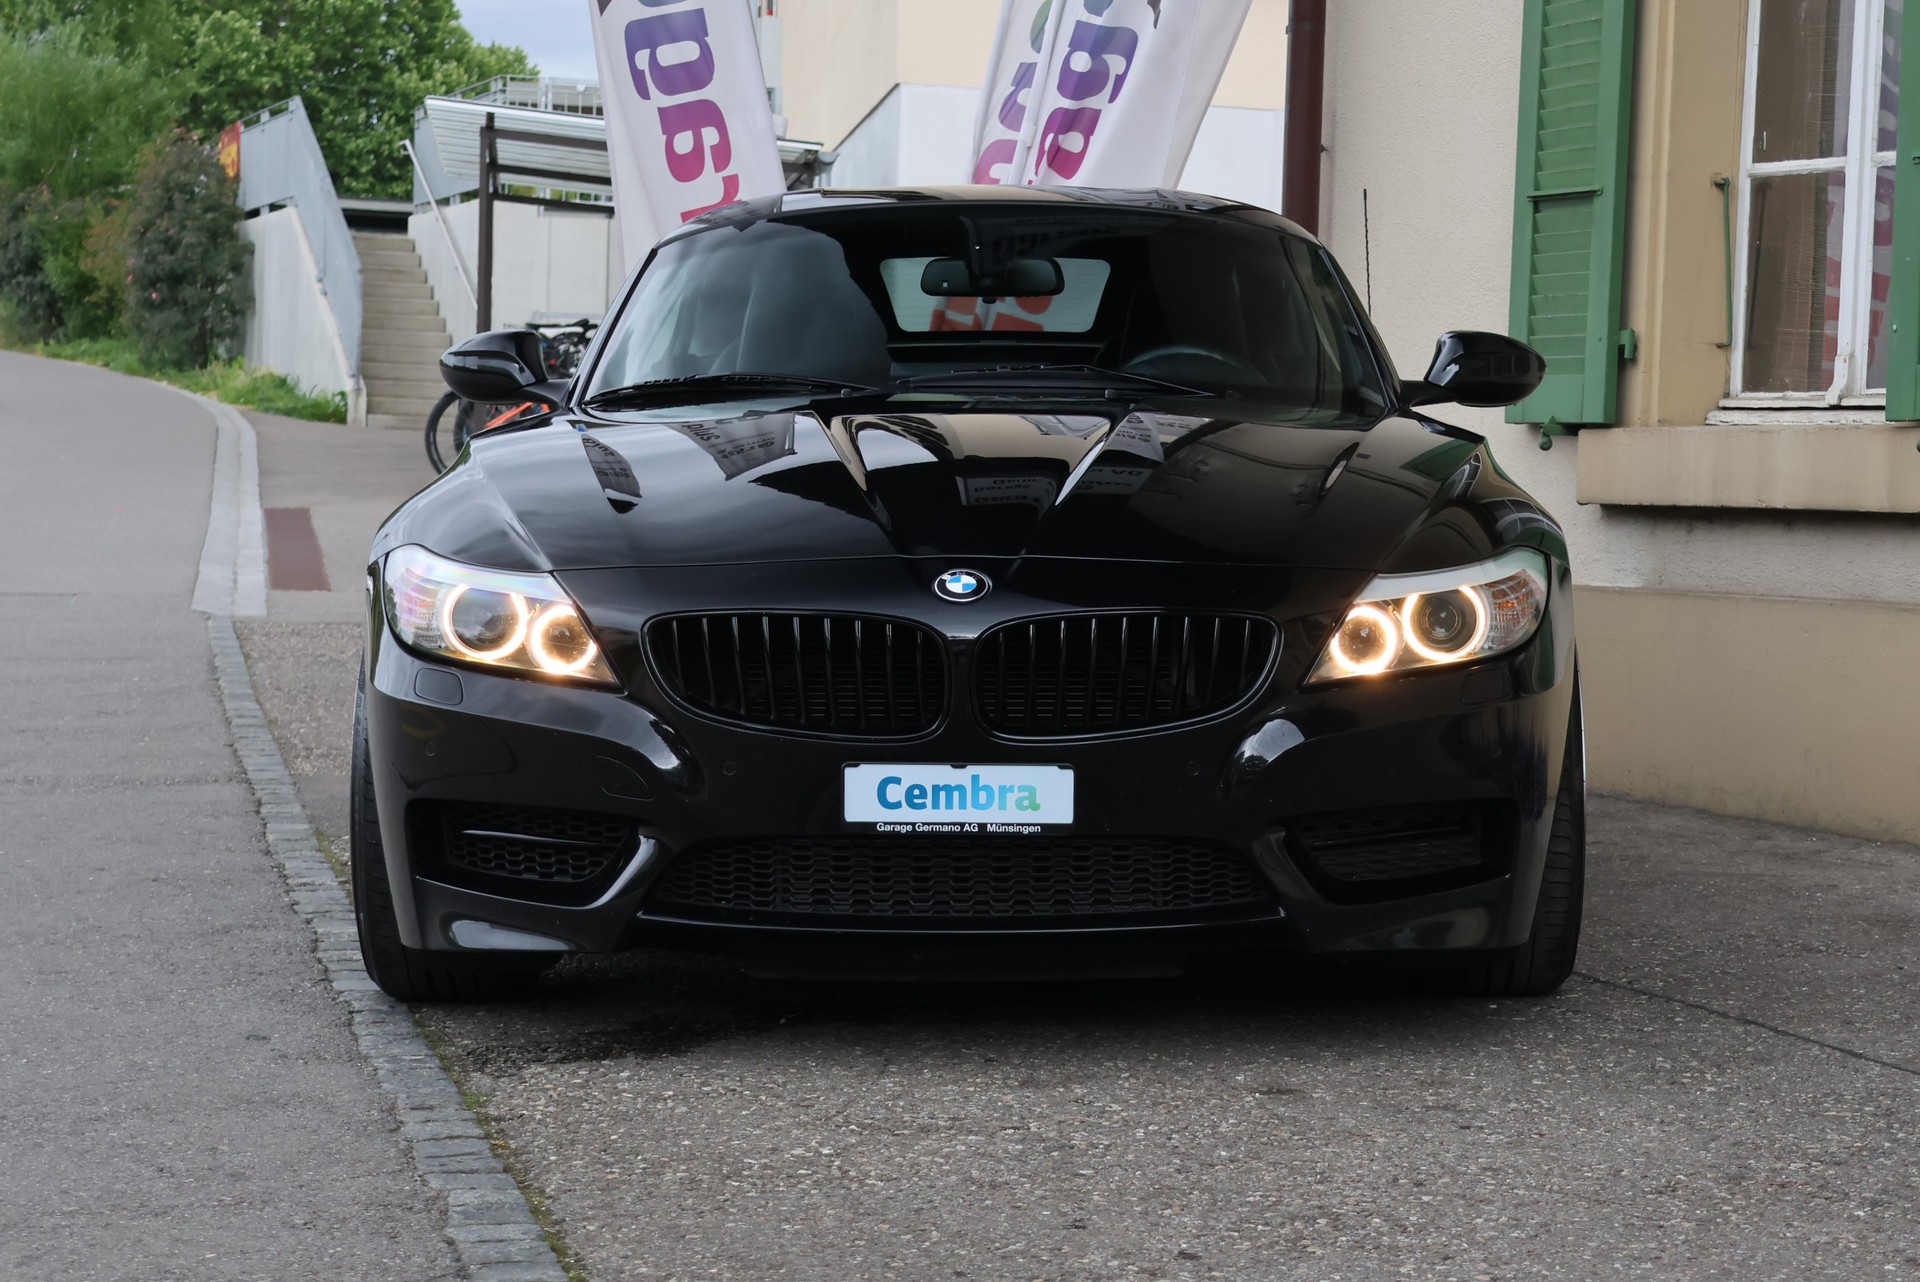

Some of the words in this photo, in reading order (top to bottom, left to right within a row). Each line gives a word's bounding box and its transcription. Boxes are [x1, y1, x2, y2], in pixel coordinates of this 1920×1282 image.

[876, 774, 1041, 812] Cembra
[876, 822, 913, 834] Garage
[915, 823, 961, 832] Germano
[963, 823, 979, 832] AG
[986, 823, 1041, 834] Münsingen
